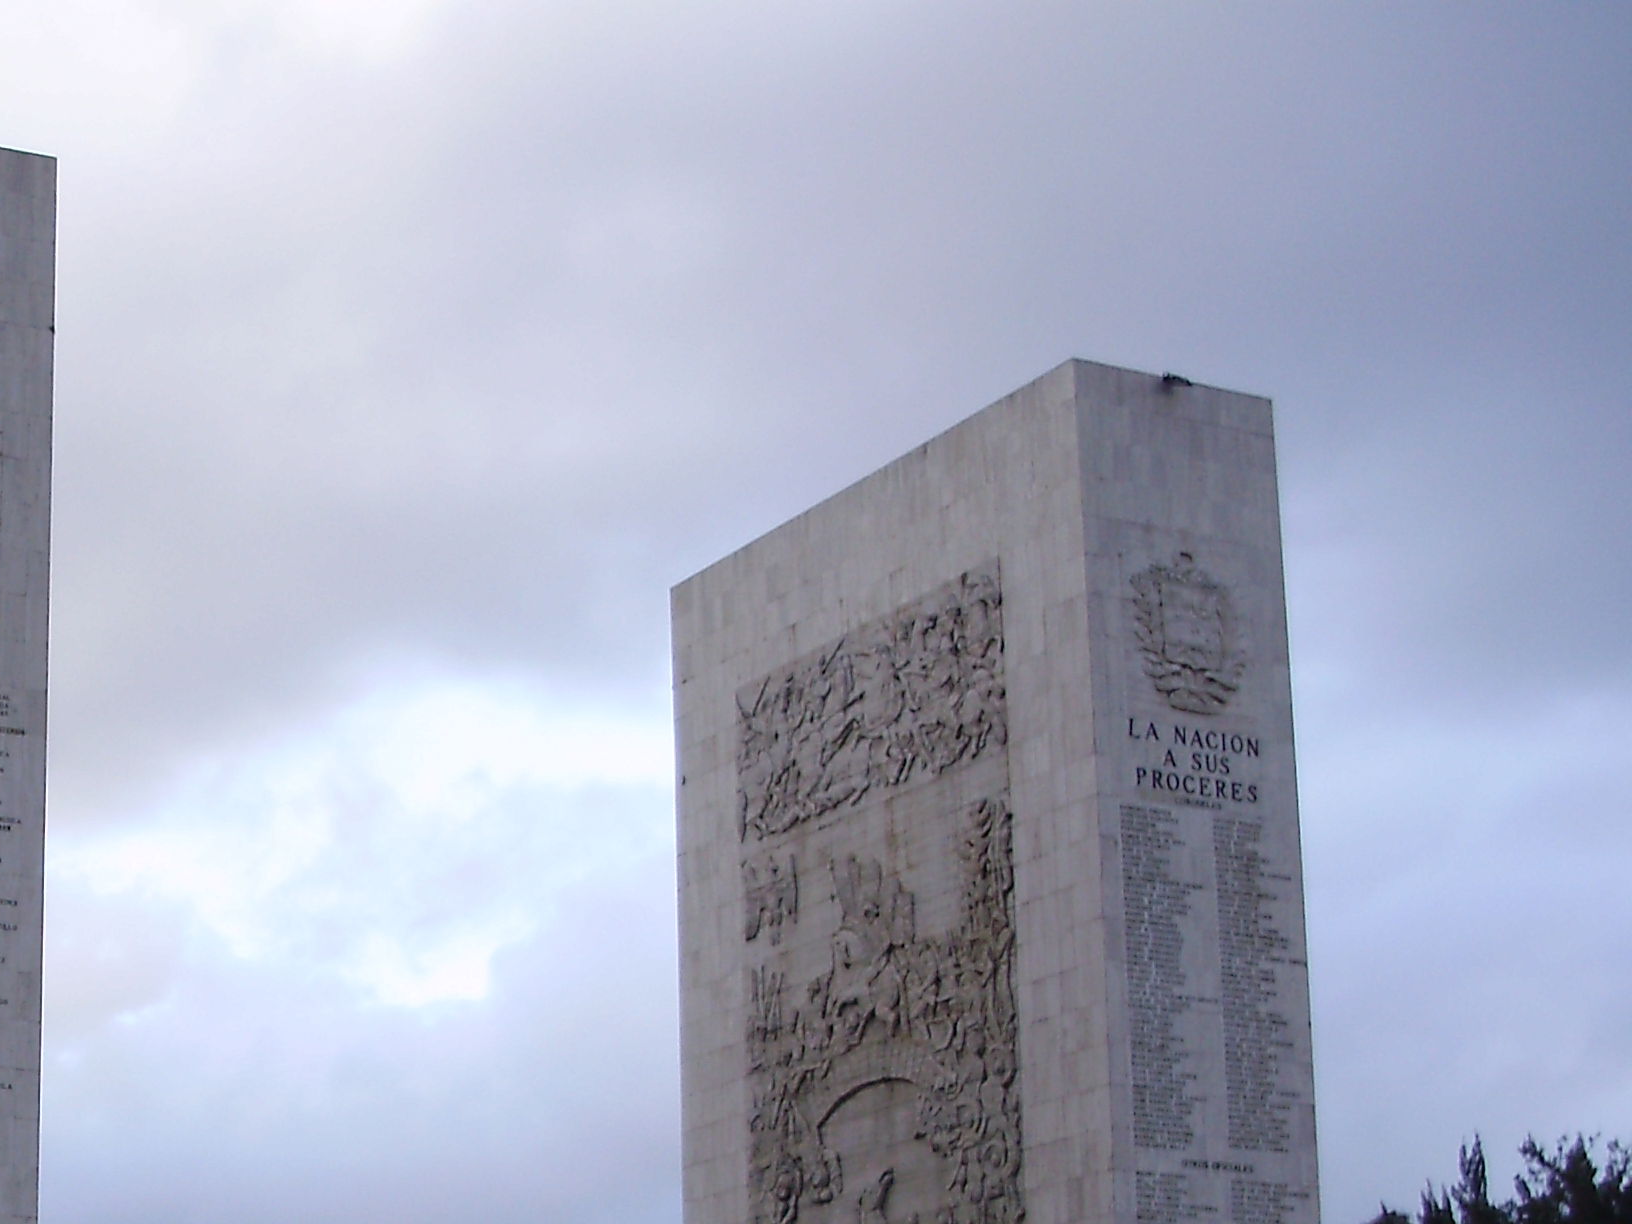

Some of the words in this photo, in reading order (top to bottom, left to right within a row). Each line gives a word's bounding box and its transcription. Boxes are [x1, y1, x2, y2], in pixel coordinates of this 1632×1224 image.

[1128, 718, 1159, 741] LA
[1174, 725, 1259, 757] NACION
[1163, 749, 1176, 768] A
[1191, 753, 1230, 775] SUS
[1136, 766, 1258, 803] PROCERES
